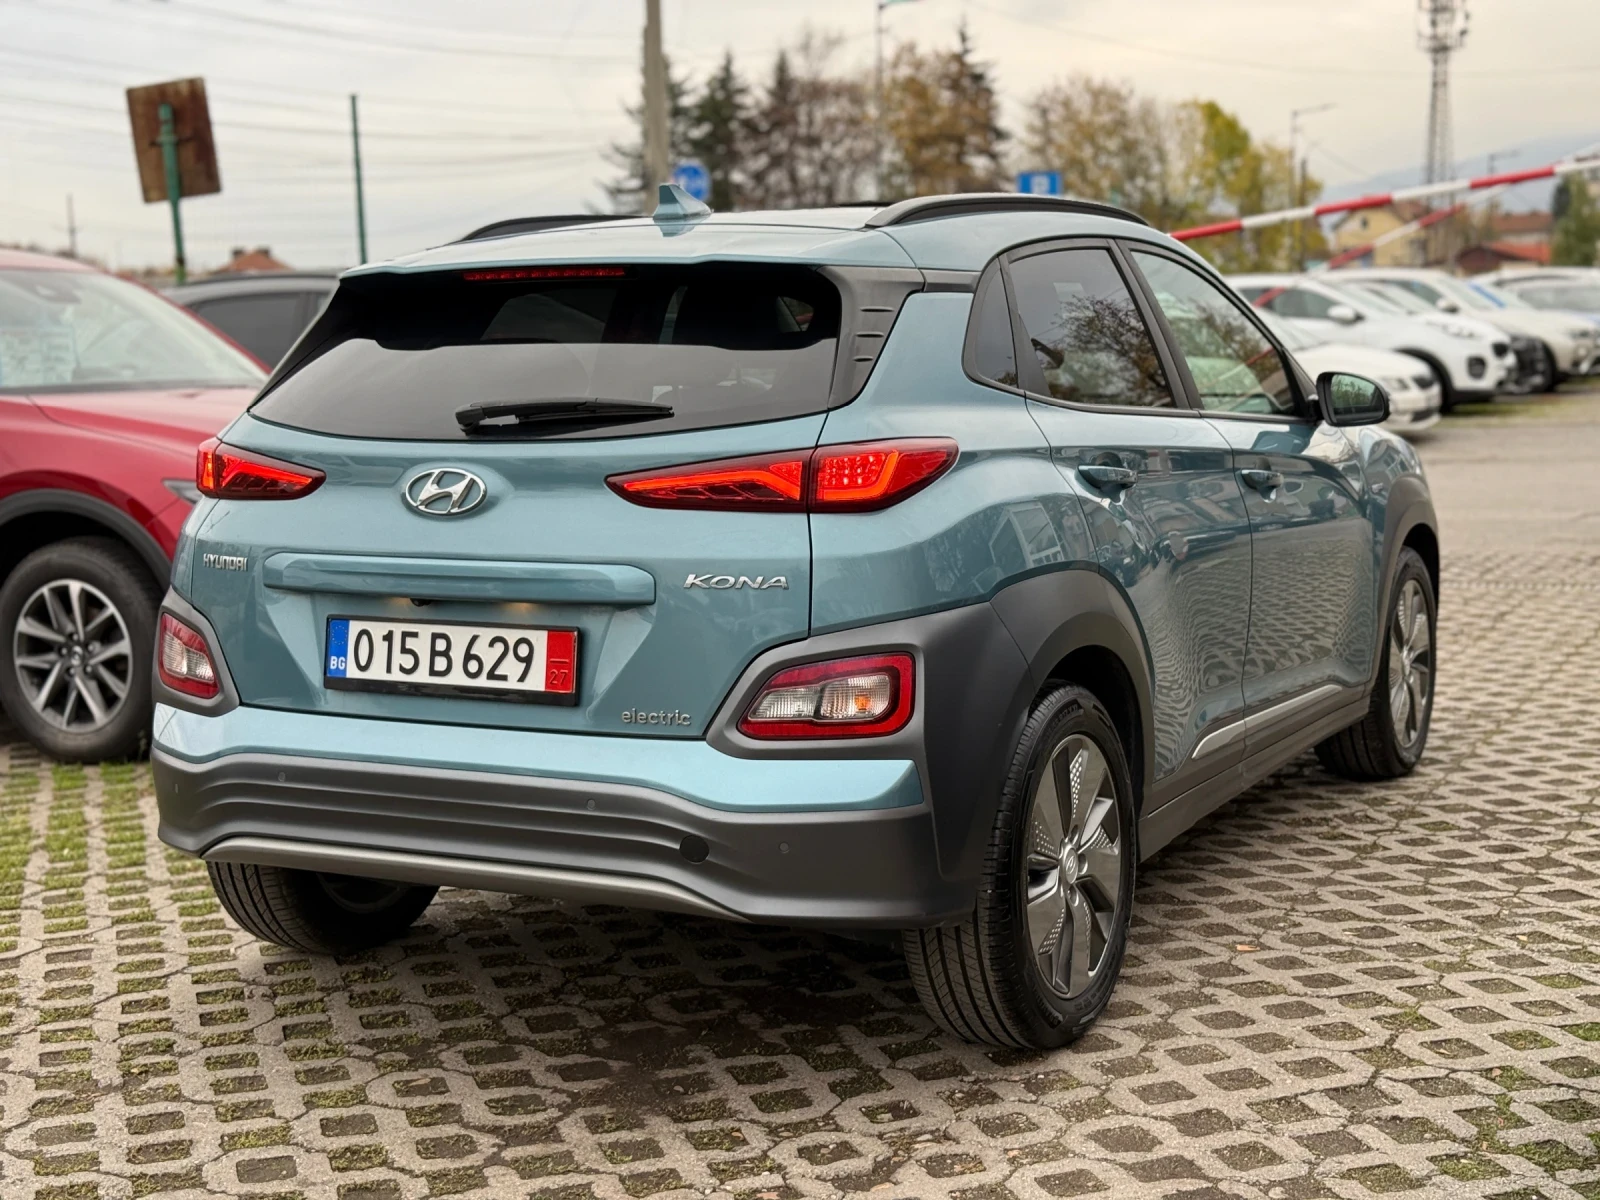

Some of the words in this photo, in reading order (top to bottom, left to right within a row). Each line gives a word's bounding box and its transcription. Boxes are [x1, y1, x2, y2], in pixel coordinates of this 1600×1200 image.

[203, 553, 248, 571] HYUNDAI
[683, 573, 789, 590] KONA
[330, 656, 346, 670] BG
[549, 669, 569, 686] 27
[621, 707, 691, 726] electric
